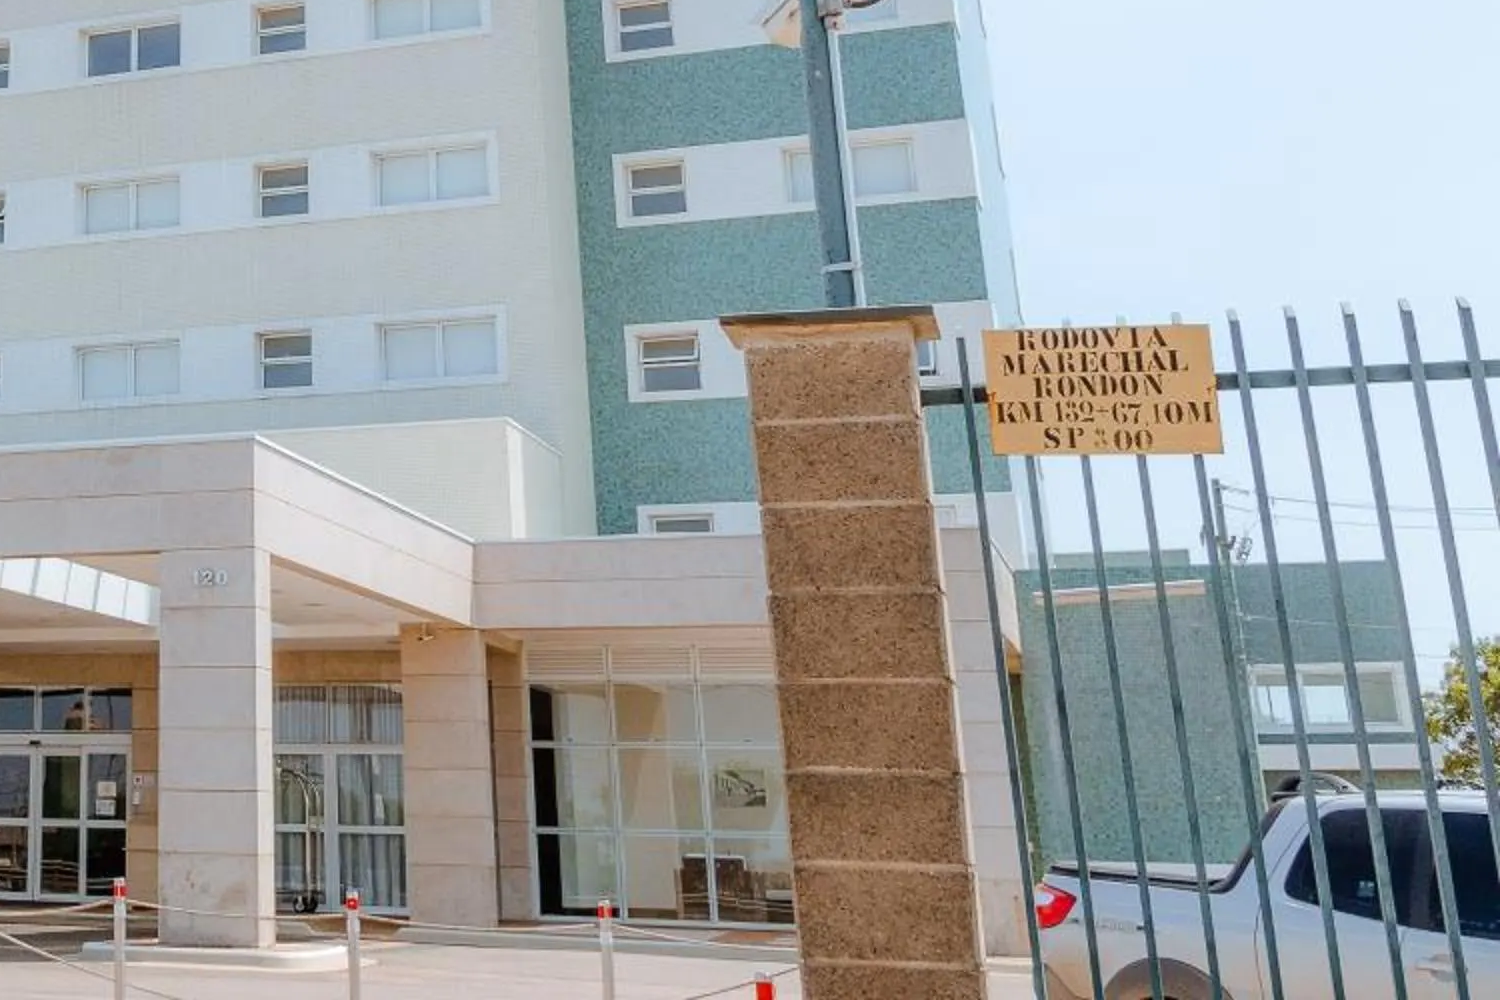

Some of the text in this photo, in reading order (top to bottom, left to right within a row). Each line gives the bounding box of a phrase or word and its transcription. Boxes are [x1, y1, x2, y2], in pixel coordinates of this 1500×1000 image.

[1015, 327, 1168, 350] RODOVIA
[1003, 349, 1188, 376] MARECHAL
[1035, 374, 1164, 398] RONDON
[997, 401, 1043, 423] KM
[1043, 427, 1085, 449] SP
[193, 569, 228, 586] 120
